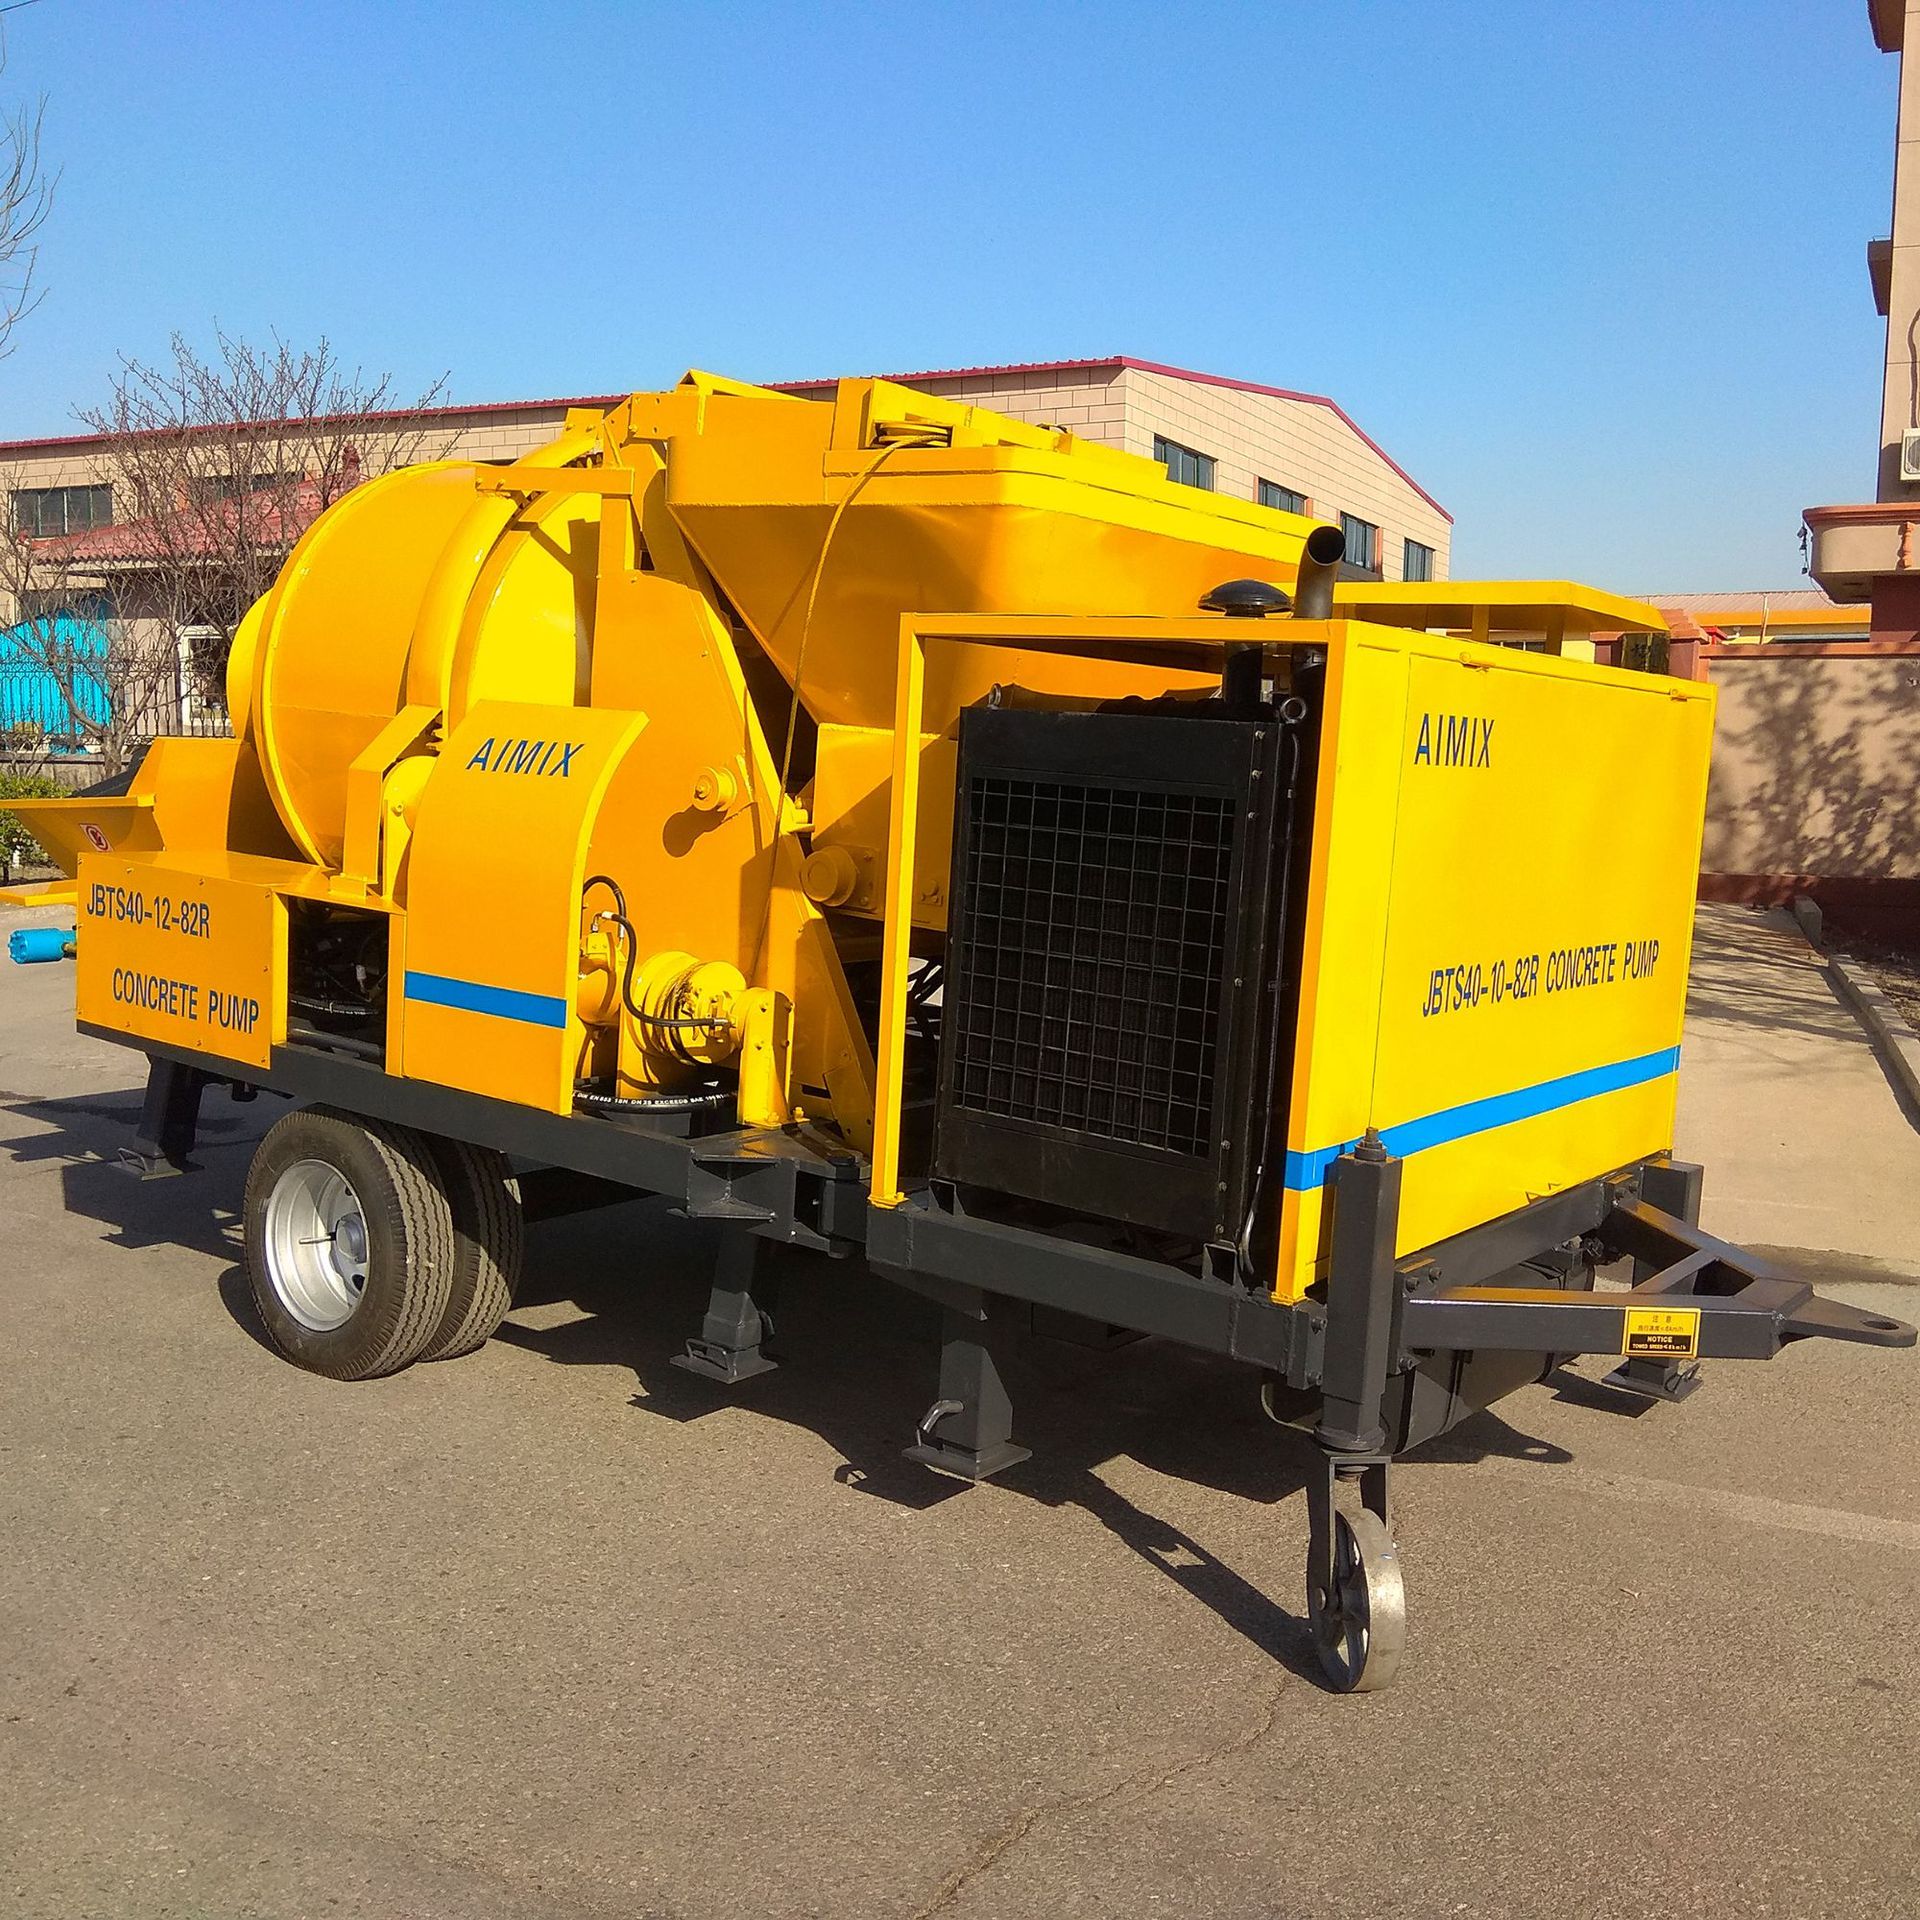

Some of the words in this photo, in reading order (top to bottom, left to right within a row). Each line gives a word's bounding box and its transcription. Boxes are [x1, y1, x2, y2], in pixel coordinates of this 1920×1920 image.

[465, 737, 585, 778] AIMIX
[1414, 713, 1495, 768] AIMIX
[86, 883, 210, 939] JBTS40-12-82R
[112, 967, 198, 1020] CONCRETE
[208, 990, 259, 1034] PUMP
[1422, 954, 1539, 1017] JBTS40-10-82R
[1545, 943, 1617, 993] CONCRETE
[1622, 939, 1659, 981] PUMP
[1647, 1335, 1673, 1343] NOTICE
